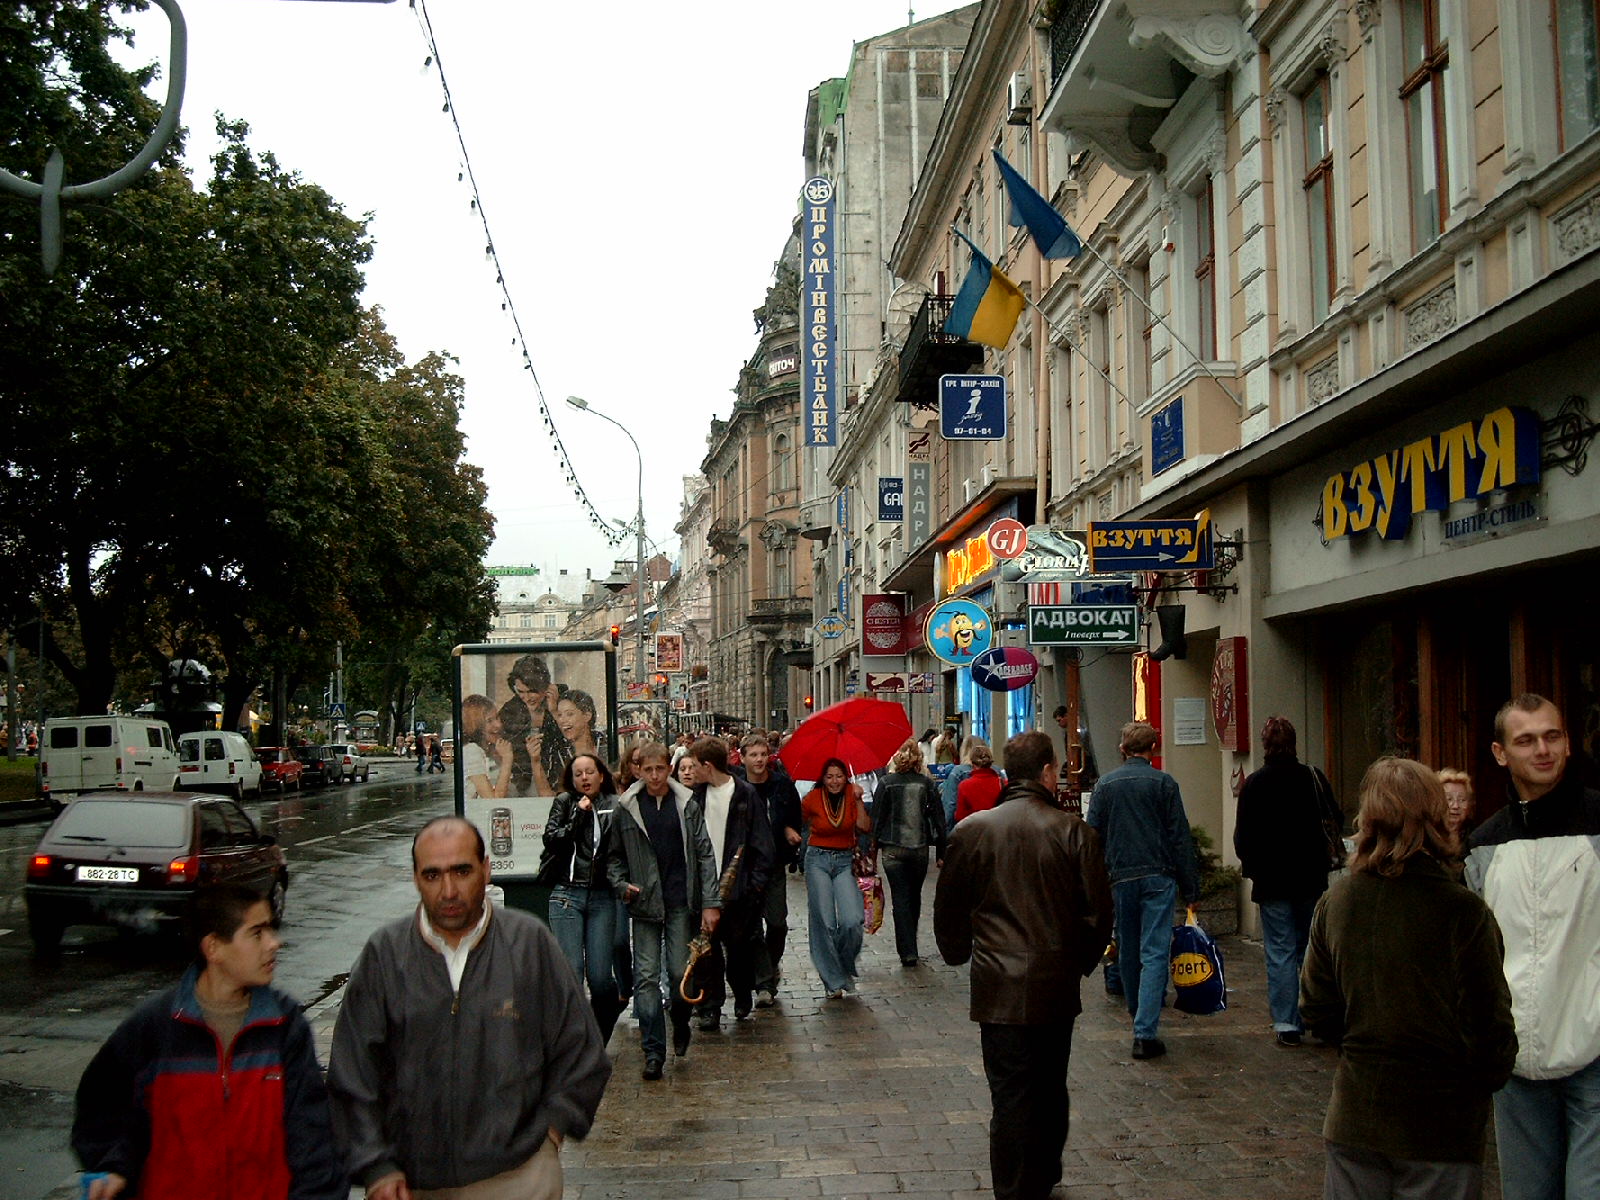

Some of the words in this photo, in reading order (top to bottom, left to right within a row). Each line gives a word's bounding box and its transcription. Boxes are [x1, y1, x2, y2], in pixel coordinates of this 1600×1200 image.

[1323, 406, 1516, 541] ВЗУТТЯ
[913, 468, 926, 548] НАДРА
[1445, 500, 1536, 539] ЦЕНТР-СТИЛЬ
[991, 529, 1023, 554] GJ
[1093, 528, 1192, 550] ВЗУТТЯ
[1034, 610, 1133, 629] АДВОКАТ
